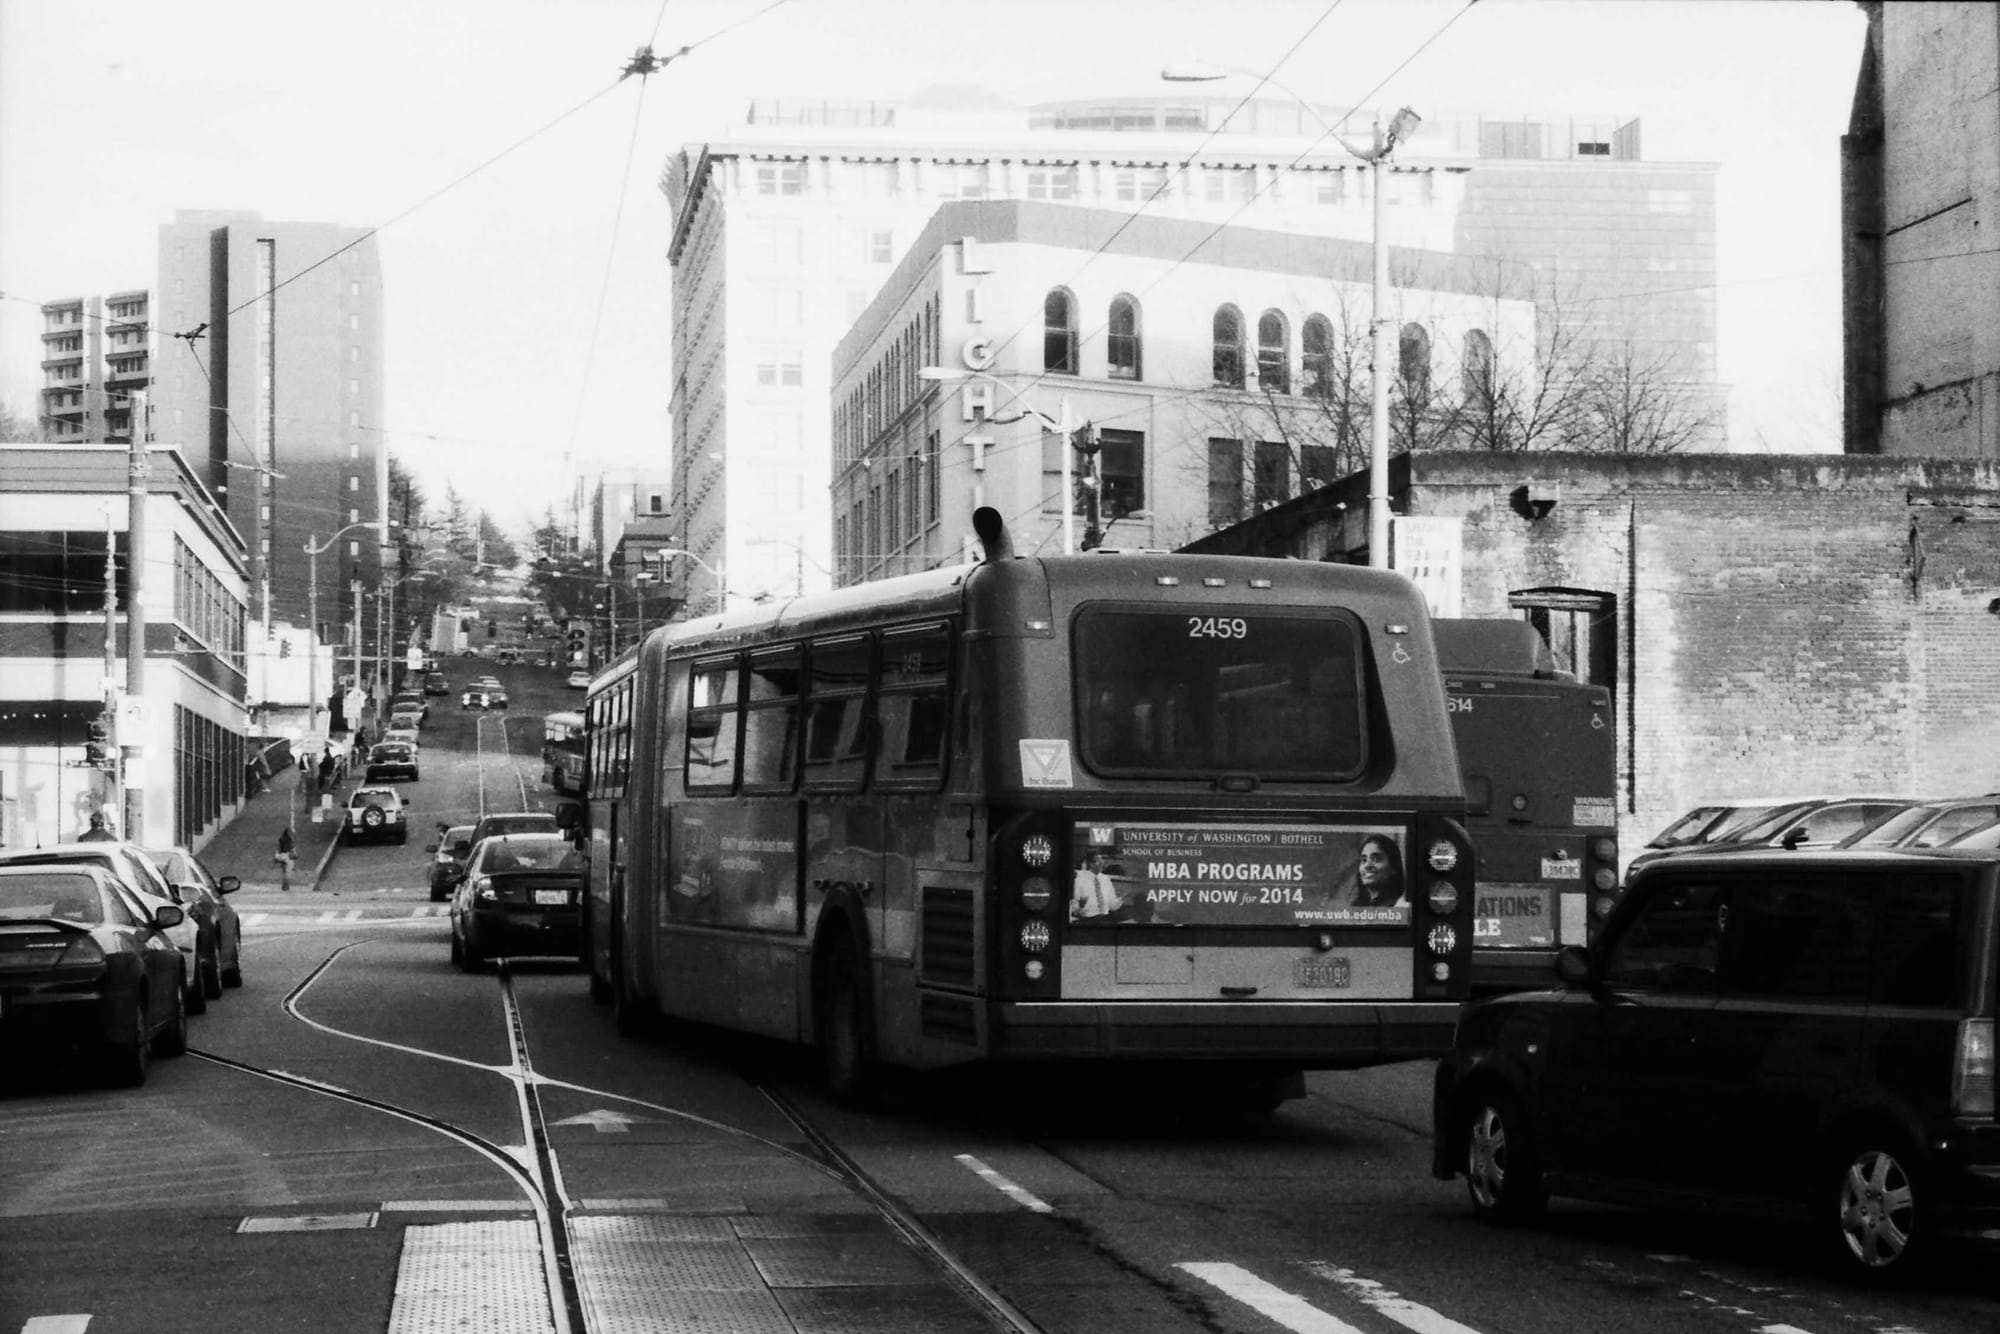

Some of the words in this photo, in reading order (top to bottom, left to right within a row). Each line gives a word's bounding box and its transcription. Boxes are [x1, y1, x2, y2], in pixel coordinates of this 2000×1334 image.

[1188, 616, 1247, 639] 2459
[1092, 828, 1112, 843] W
[1123, 832, 1184, 842] UNIVERSITY
[1188, 833, 1198, 843] of
[1203, 833, 1271, 844] WASHINGTON
[1281, 834, 1324, 845] BOTHELL
[1122, 848, 1152, 857] SCHOOL
[1154, 848, 1165, 857] OF
[1167, 848, 1202, 857] BUSINESS
[1148, 862, 1191, 880] MBA
[1197, 863, 1303, 881] PROGRAMS
[1146, 889, 1193, 904] APPLY
[1199, 889, 1238, 904] NOW
[1240, 888, 1257, 906] for
[1259, 888, 1303, 904] 2014
[1294, 908, 1402, 921] www.uwb.edu/mba
